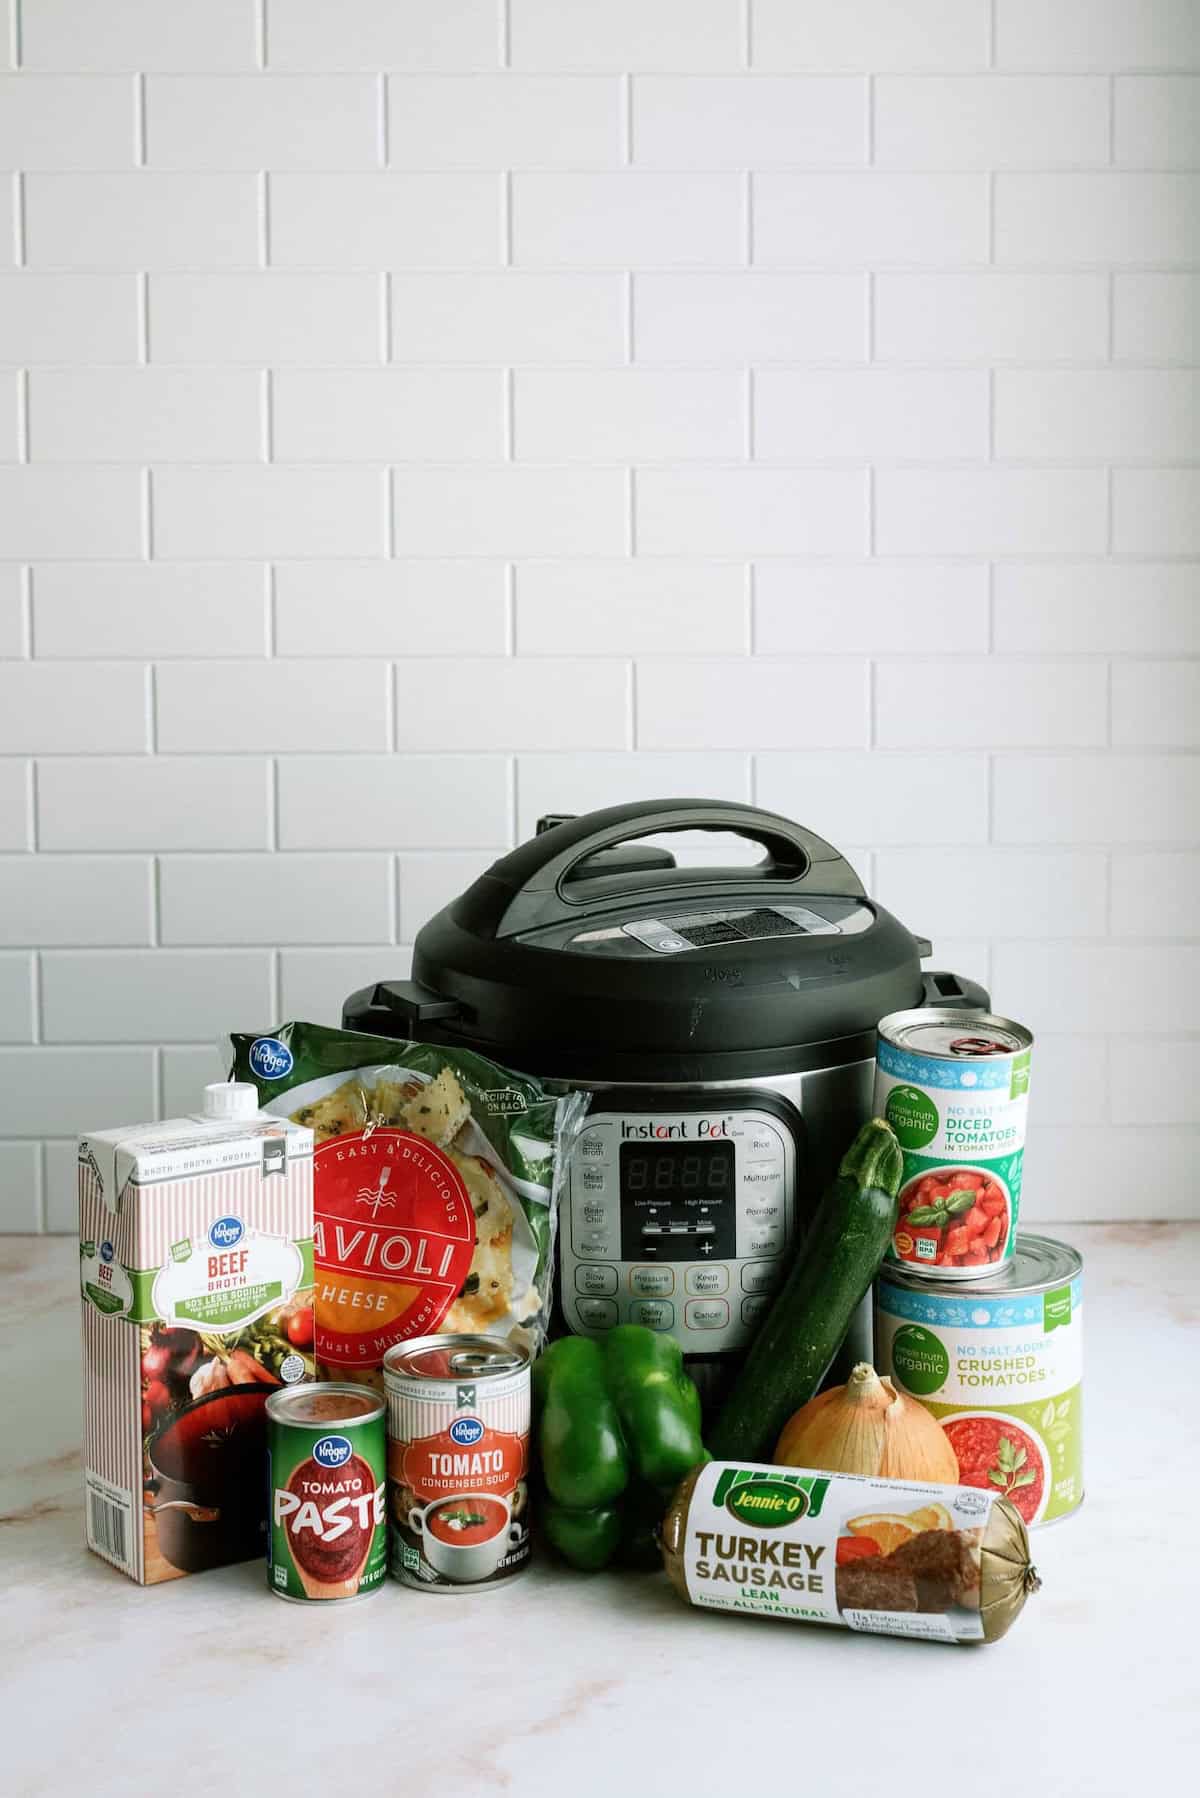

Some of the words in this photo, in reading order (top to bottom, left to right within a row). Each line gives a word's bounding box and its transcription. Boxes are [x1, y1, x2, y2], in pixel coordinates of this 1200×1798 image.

[252, 1043, 289, 1072] Kroger
[480, 1092, 512, 1104] RECIPE
[487, 1103, 499, 1112] ON
[500, 1102, 527, 1111] BACK
[913, 1111, 934, 1121] truth
[947, 1106, 965, 1116] NO
[621, 1120, 688, 1139] Instant
[697, 1118, 729, 1138] Pot
[888, 1112, 934, 1132] organic
[945, 1118, 992, 1130] DICED
[945, 1126, 1017, 1143] TOMATOES
[945, 1144, 955, 1152] IN
[958, 1143, 994, 1152] TOMATO
[337, 1145, 377, 1161] EASY
[402, 1149, 457, 1223] DELICIOUS
[215, 1222, 241, 1243] Kroger
[314, 1222, 455, 1277] AVIOLI
[208, 1249, 250, 1278] BEEF
[208, 1275, 247, 1292] BROTH
[317, 1335, 350, 1353] Just
[373, 1297, 439, 1351] Minutes!
[920, 1351, 944, 1362] truth
[957, 1344, 977, 1356] NO
[980, 1345, 1009, 1356] SALT
[895, 1354, 944, 1375] organic
[957, 1355, 1037, 1372] CRUSHED
[957, 1369, 1046, 1387] TOMATOES
[455, 1424, 481, 1441] Kroger
[319, 1441, 348, 1463] Kroger
[428, 1449, 504, 1476] TOMATO
[302, 1478, 363, 1494] TOMATO
[421, 1476, 483, 1489] CONDENSED
[486, 1471, 511, 1486] SOUP
[734, 1491, 801, 1513] Jennie-O
[274, 1482, 386, 1542] PASTE
[695, 1532, 826, 1570] TURKEY
[695, 1560, 824, 1593] SAUSAGE
[741, 1587, 780, 1601] LEAN
[733, 1600, 827, 1618] ALL-NATURAL
